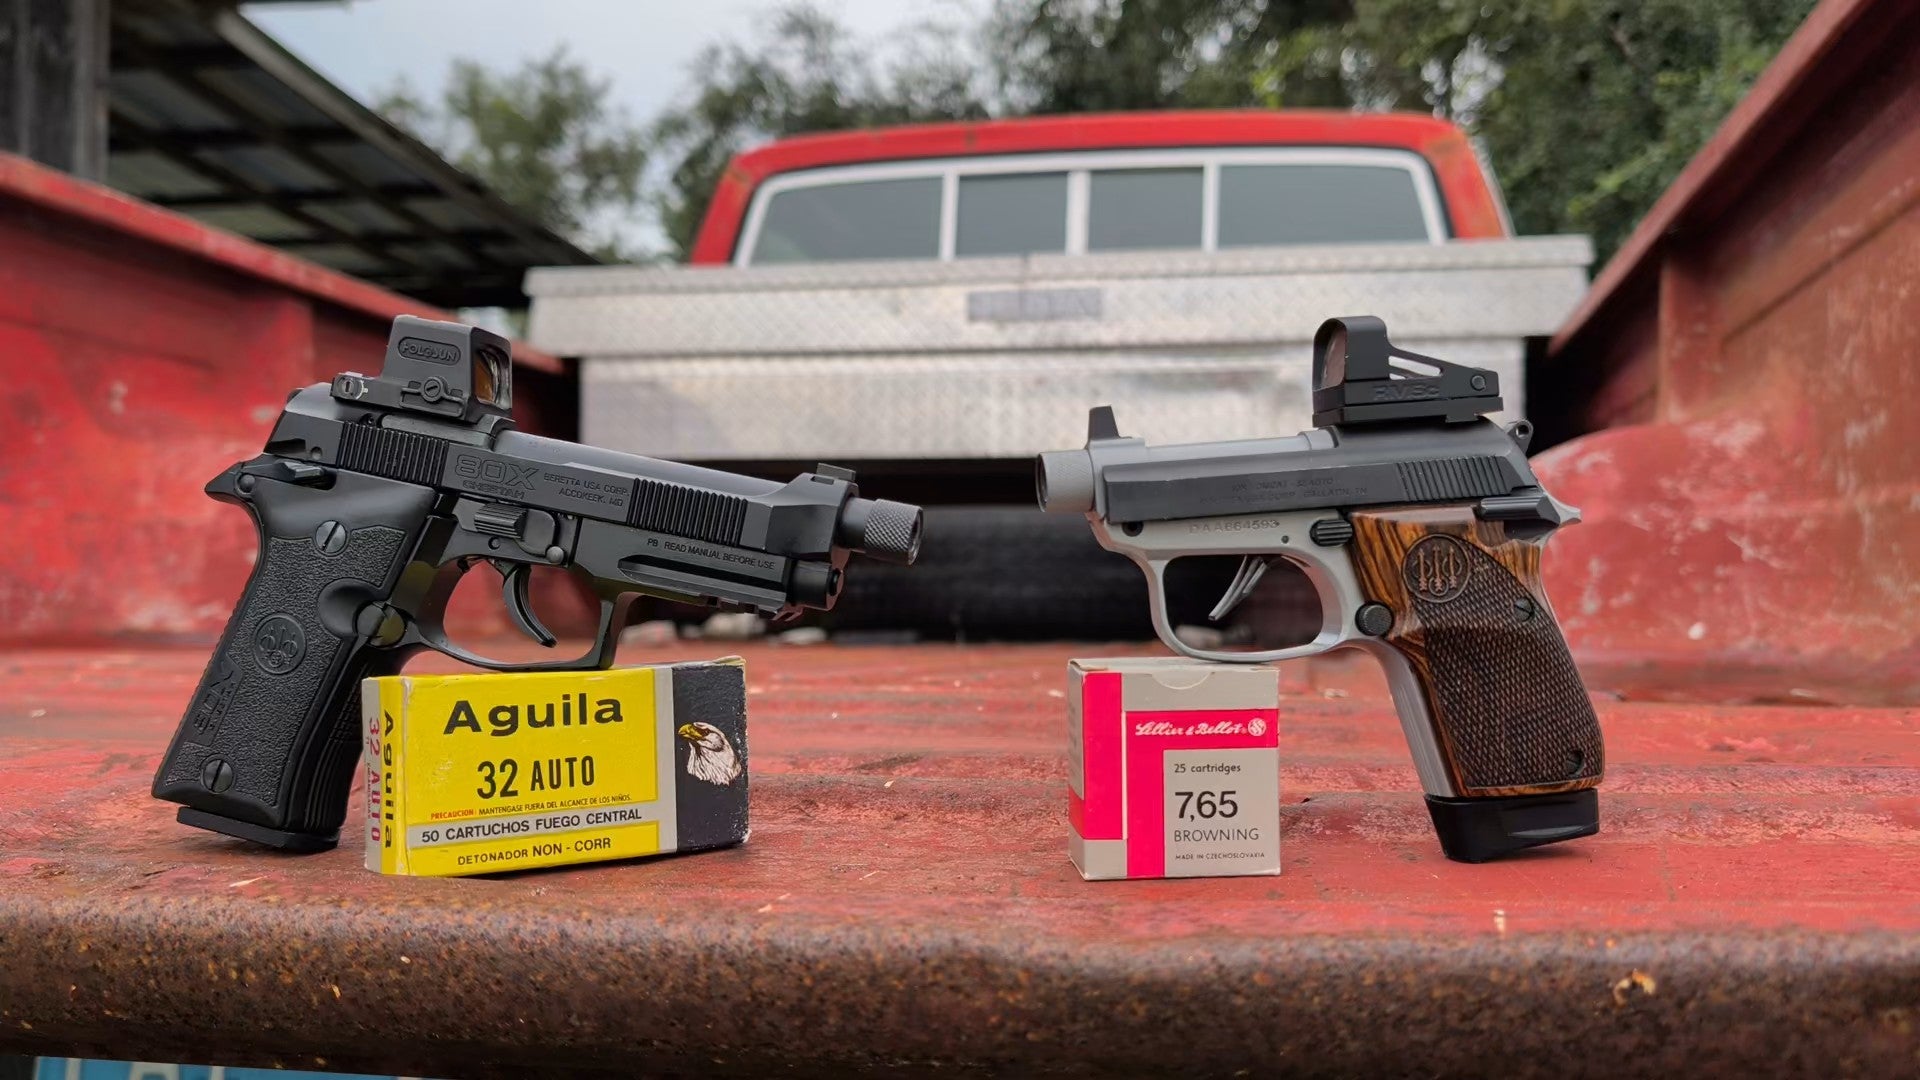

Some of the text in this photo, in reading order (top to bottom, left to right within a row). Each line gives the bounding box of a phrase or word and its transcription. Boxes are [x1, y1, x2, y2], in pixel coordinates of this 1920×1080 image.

[455, 453, 539, 491] 80X
[543, 472, 581, 487] BERETTA
[583, 480, 601, 490] USA
[609, 497, 624, 507] MD
[646, 537, 776, 570] PB READ MANUAL BEFORE USE
[443, 692, 624, 737] Aguila
[369, 717, 381, 843] 32 AUTO
[383, 710, 395, 849] Aguila
[476, 755, 595, 800] 32 AUTO
[1174, 763, 1242, 776] 25 cartridges
[478, 804, 524, 816] MANTENGASE
[524, 801, 545, 812] FUERA
[546, 800, 558, 809] DEL
[559, 797, 589, 808] ALCANCE
[589, 797, 598, 805] DE
[598, 796, 610, 804] LOS
[1174, 790, 1239, 822] 7,65
[421, 808, 643, 843] 50 CARTUCHOS FUEGO CENTRAL
[1174, 828, 1260, 843] BROWNING
[457, 849, 529, 866] DETONADOR
[532, 843, 563, 857] NON
[574, 837, 612, 851] CORR
[1206, 852, 1265, 860] CZECHOSLOVAKIA
